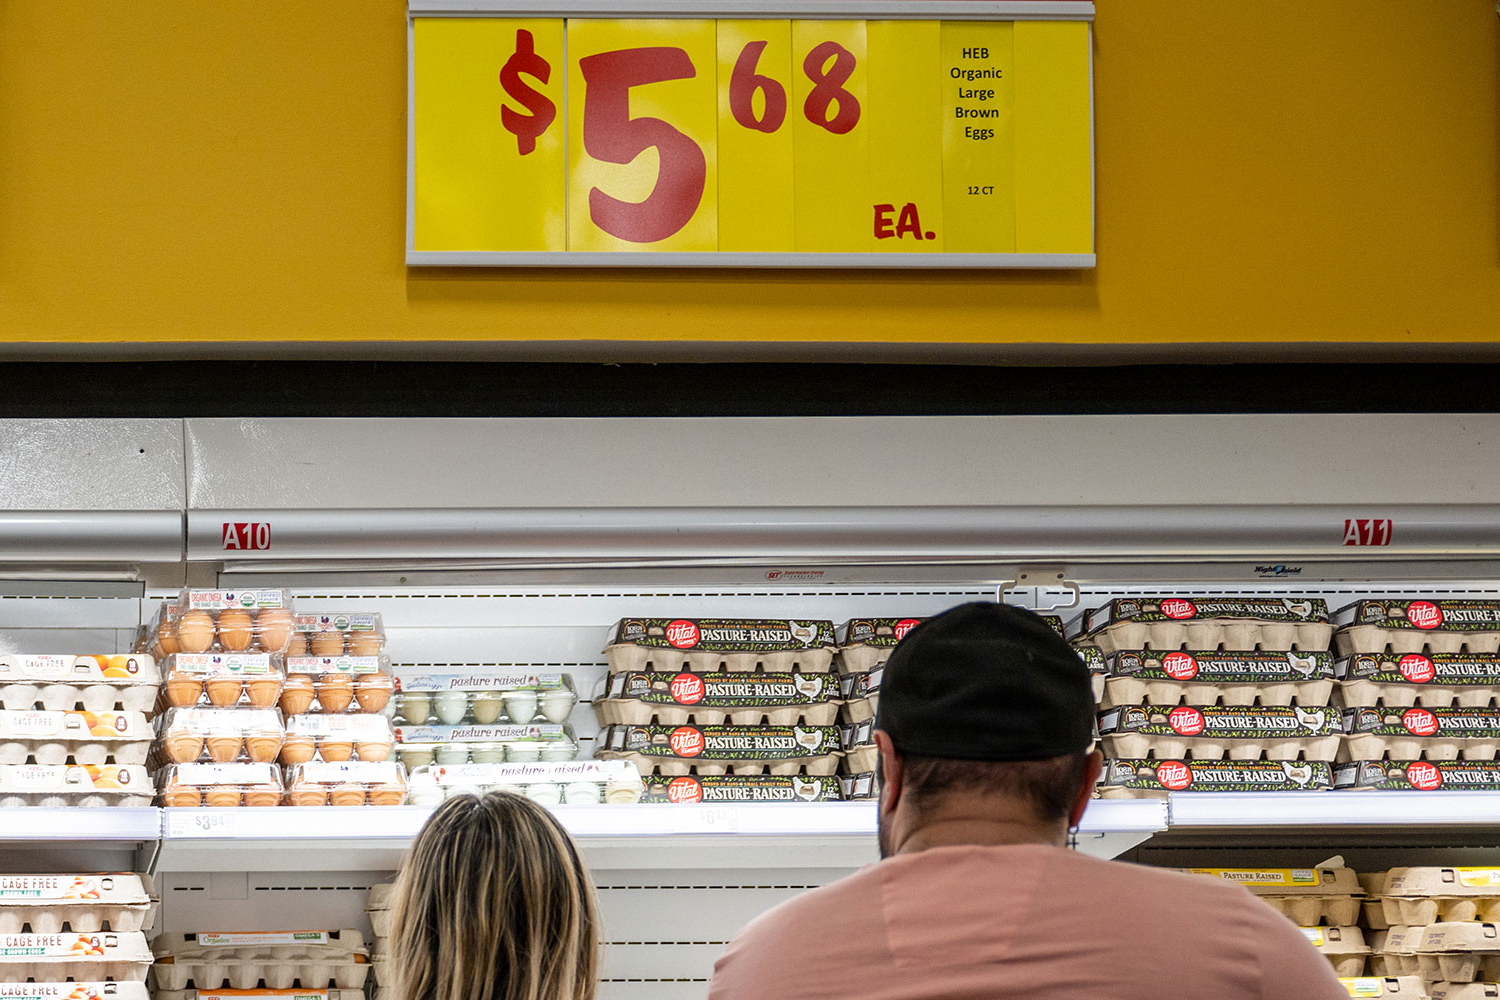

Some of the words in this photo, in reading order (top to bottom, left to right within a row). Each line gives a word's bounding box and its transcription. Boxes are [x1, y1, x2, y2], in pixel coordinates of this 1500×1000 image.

[962, 48, 989, 59] HEB
[950, 66, 1002, 82] Organic
[958, 87, 995, 102] Large
[955, 106, 1000, 119] Brown
[965, 126, 994, 141] Eggs
[967, 185, 979, 195] 12
[981, 185, 994, 195] CT
[873, 202, 936, 240] EA.
[222, 523, 271, 550] A10
[1342, 519, 1393, 546] A11
[668, 625, 696, 640] Vital
[700, 629, 791, 642] PASTURE-RAISED
[1164, 658, 1193, 672] Vital
[1198, 661, 1290, 673] PASTURE-RAISED
[450, 676, 490, 688] pasture
[494, 675, 526, 686] raised
[672, 679, 700, 694] Vital
[705, 683, 796, 696] PASTURE-RAISED
[1170, 713, 1200, 727] Vital
[1205, 716, 1298, 729] PASTURE-RAISED
[451, 727, 491, 740] pasture
[495, 726, 528, 737] raised
[1158, 767, 1187, 782] Vital
[1192, 770, 1286, 783] PASTURE-RAISED
